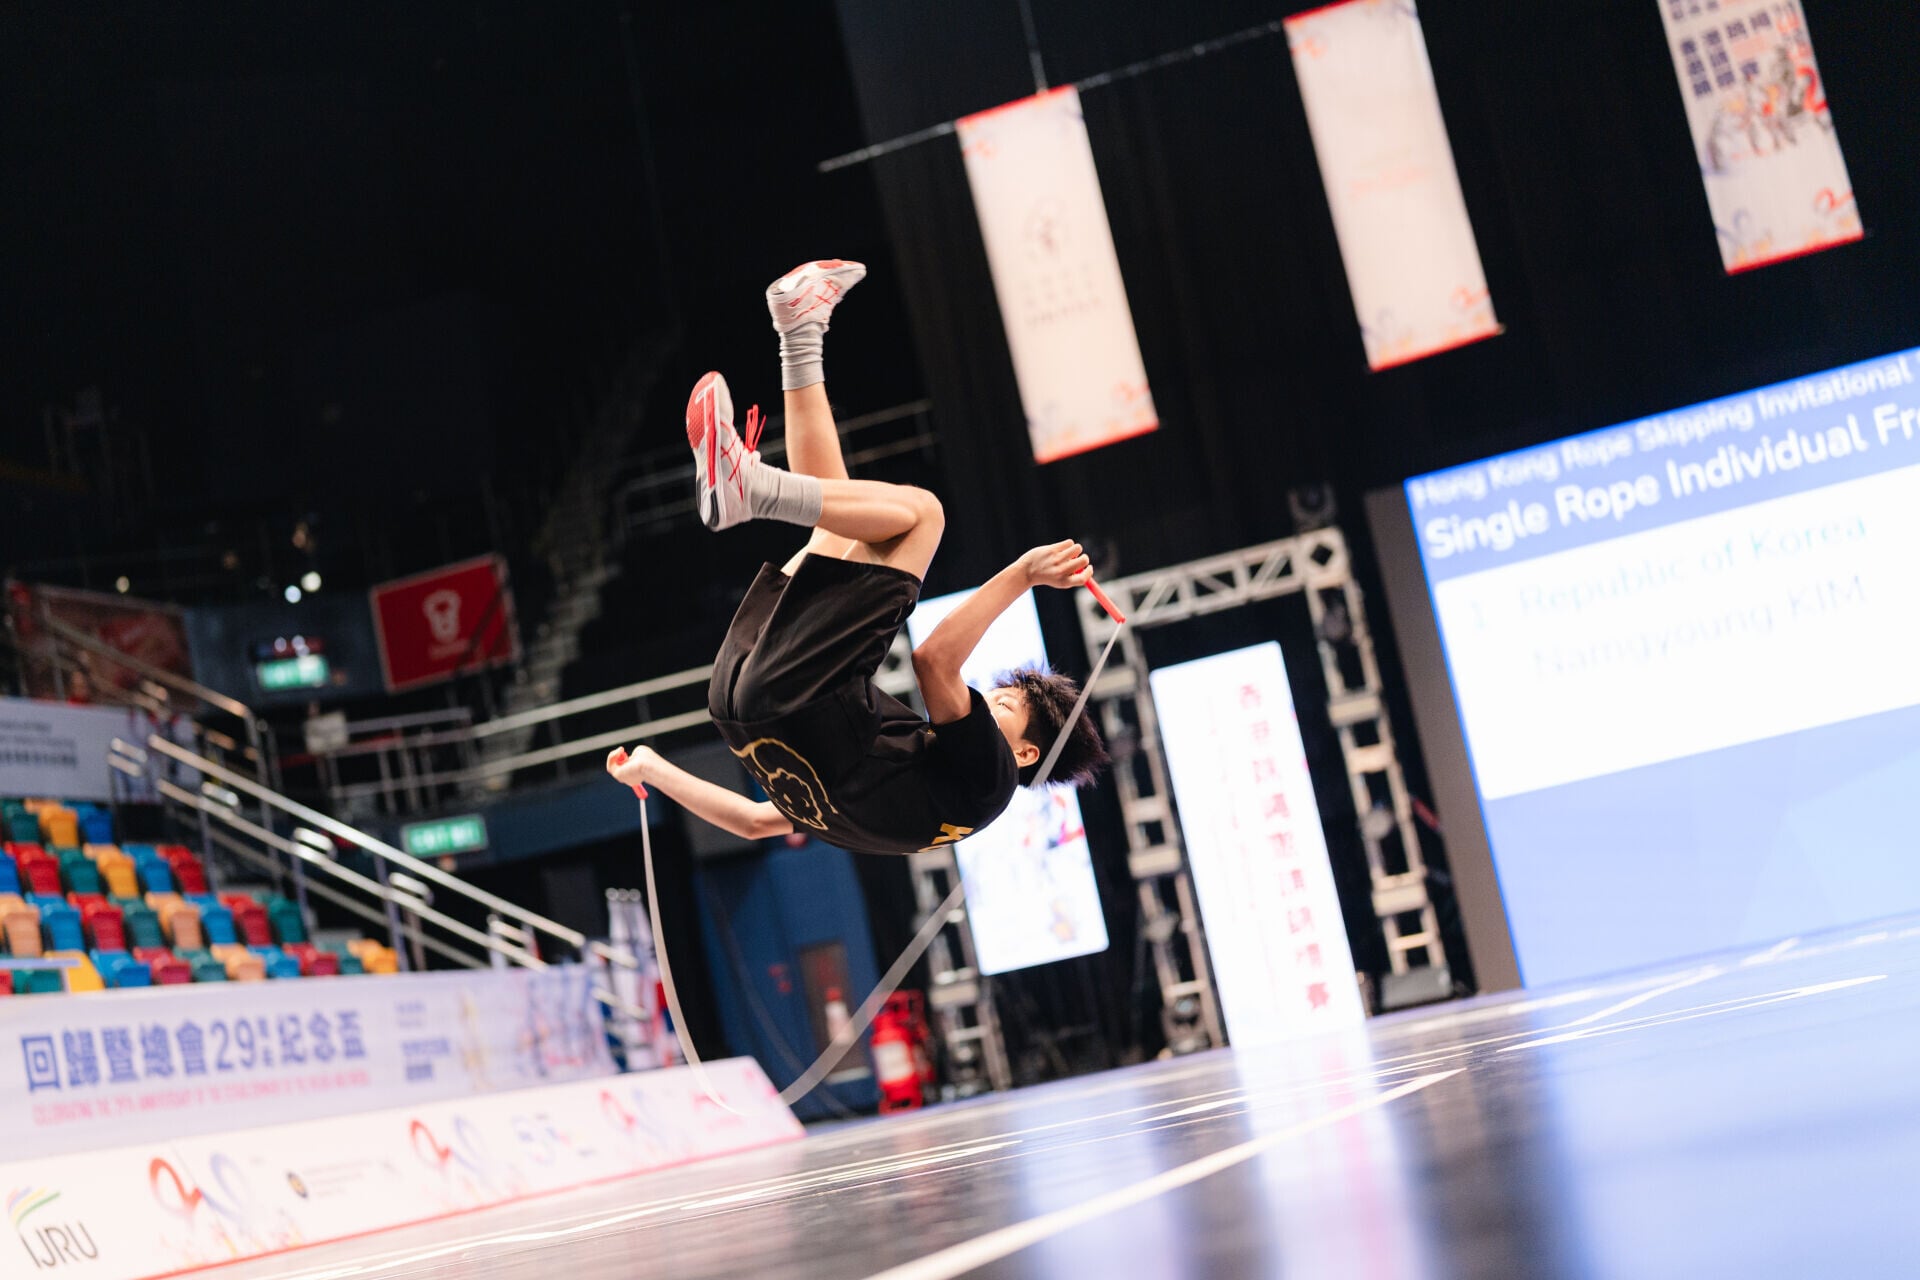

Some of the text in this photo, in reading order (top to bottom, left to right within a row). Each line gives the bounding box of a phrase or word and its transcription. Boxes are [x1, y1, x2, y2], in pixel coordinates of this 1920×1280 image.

[1412, 354, 1914, 509] Hong Kong Rope Skipping Invitational
[1424, 401, 1920, 559] Single Rope Individual Fr
[1518, 512, 1868, 618] Republic of Korea
[1785, 570, 1870, 622] KIM
[19, 1221, 99, 1268] IJRU
